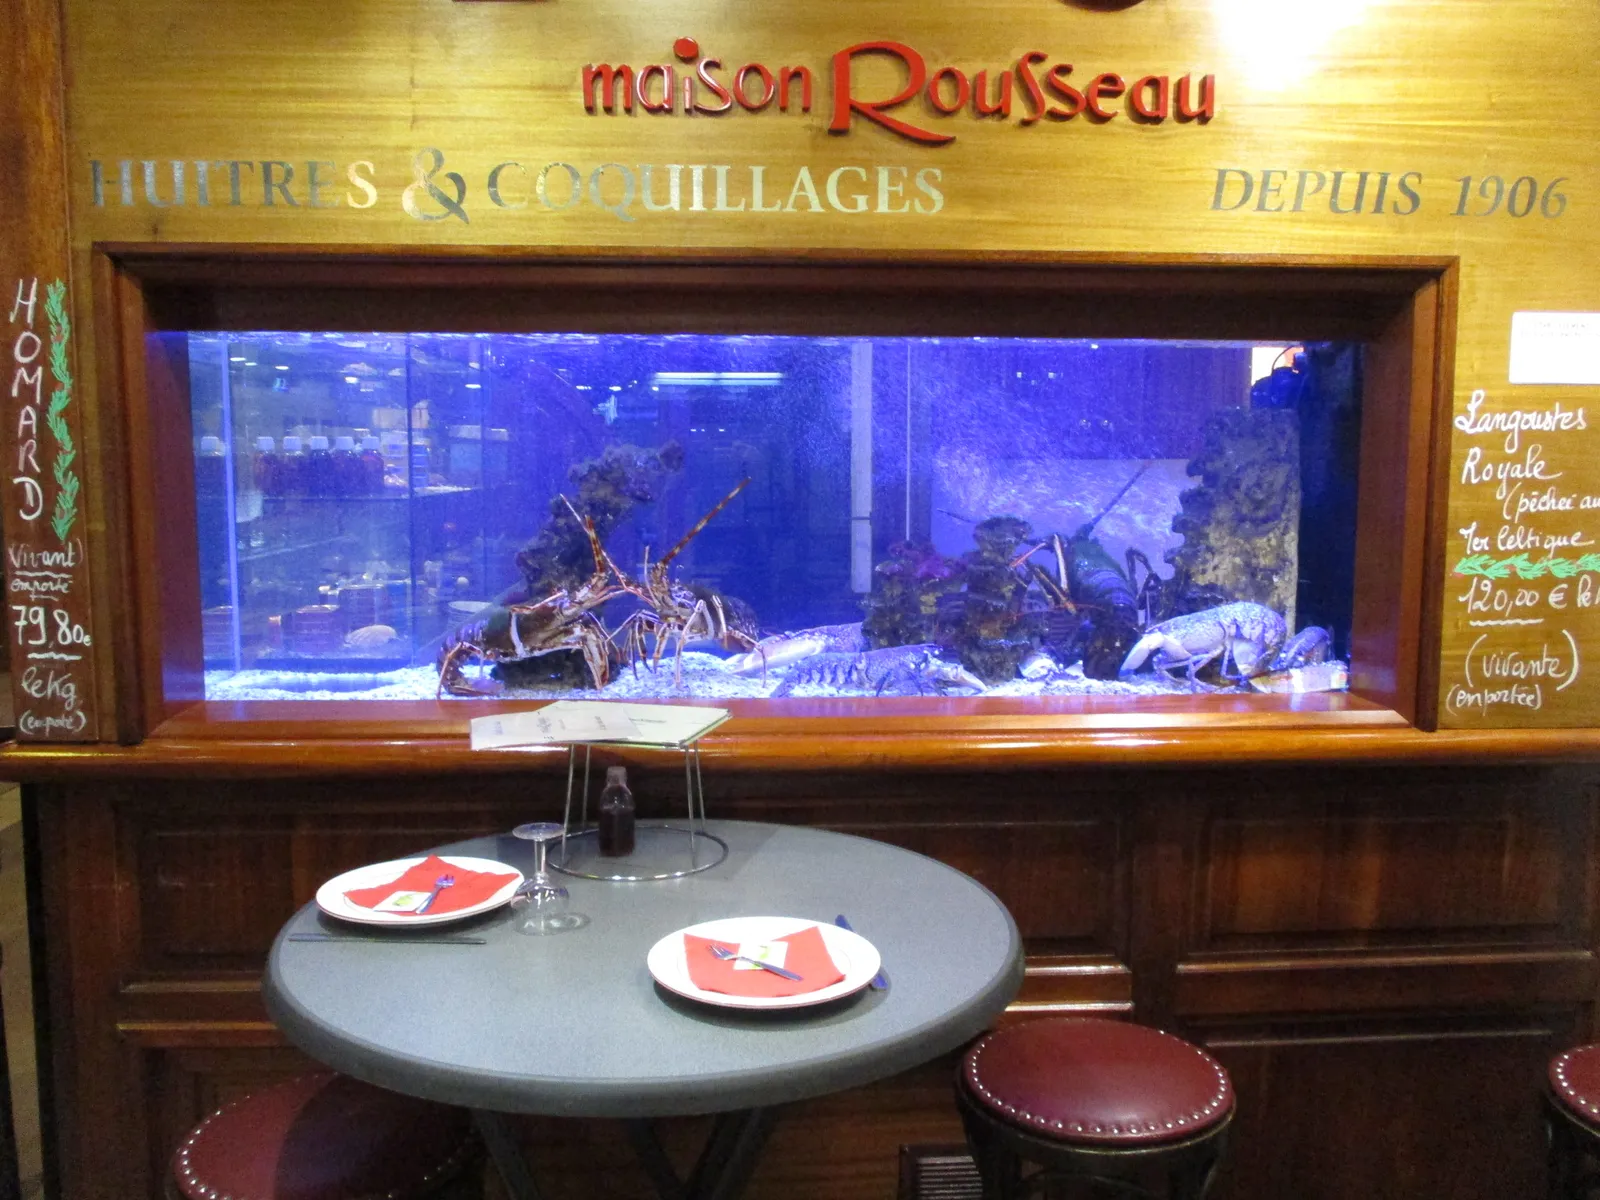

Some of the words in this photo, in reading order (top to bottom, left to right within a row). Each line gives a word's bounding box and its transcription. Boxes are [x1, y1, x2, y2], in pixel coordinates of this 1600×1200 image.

[582, 36, 811, 113] maison
[827, 41, 1216, 144] Rousseau
[90, 158, 376, 209] HUITRES
[402, 147, 469, 225] &
[488, 160, 945, 222] COQUILLAGES
[1210, 167, 1422, 216] DEPUIS
[1450, 174, 1569, 219] 1906
[1454, 388, 1587, 454] Langoustes
[1461, 443, 1563, 500] Royale
[1458, 576, 1540, 617] 120,00
